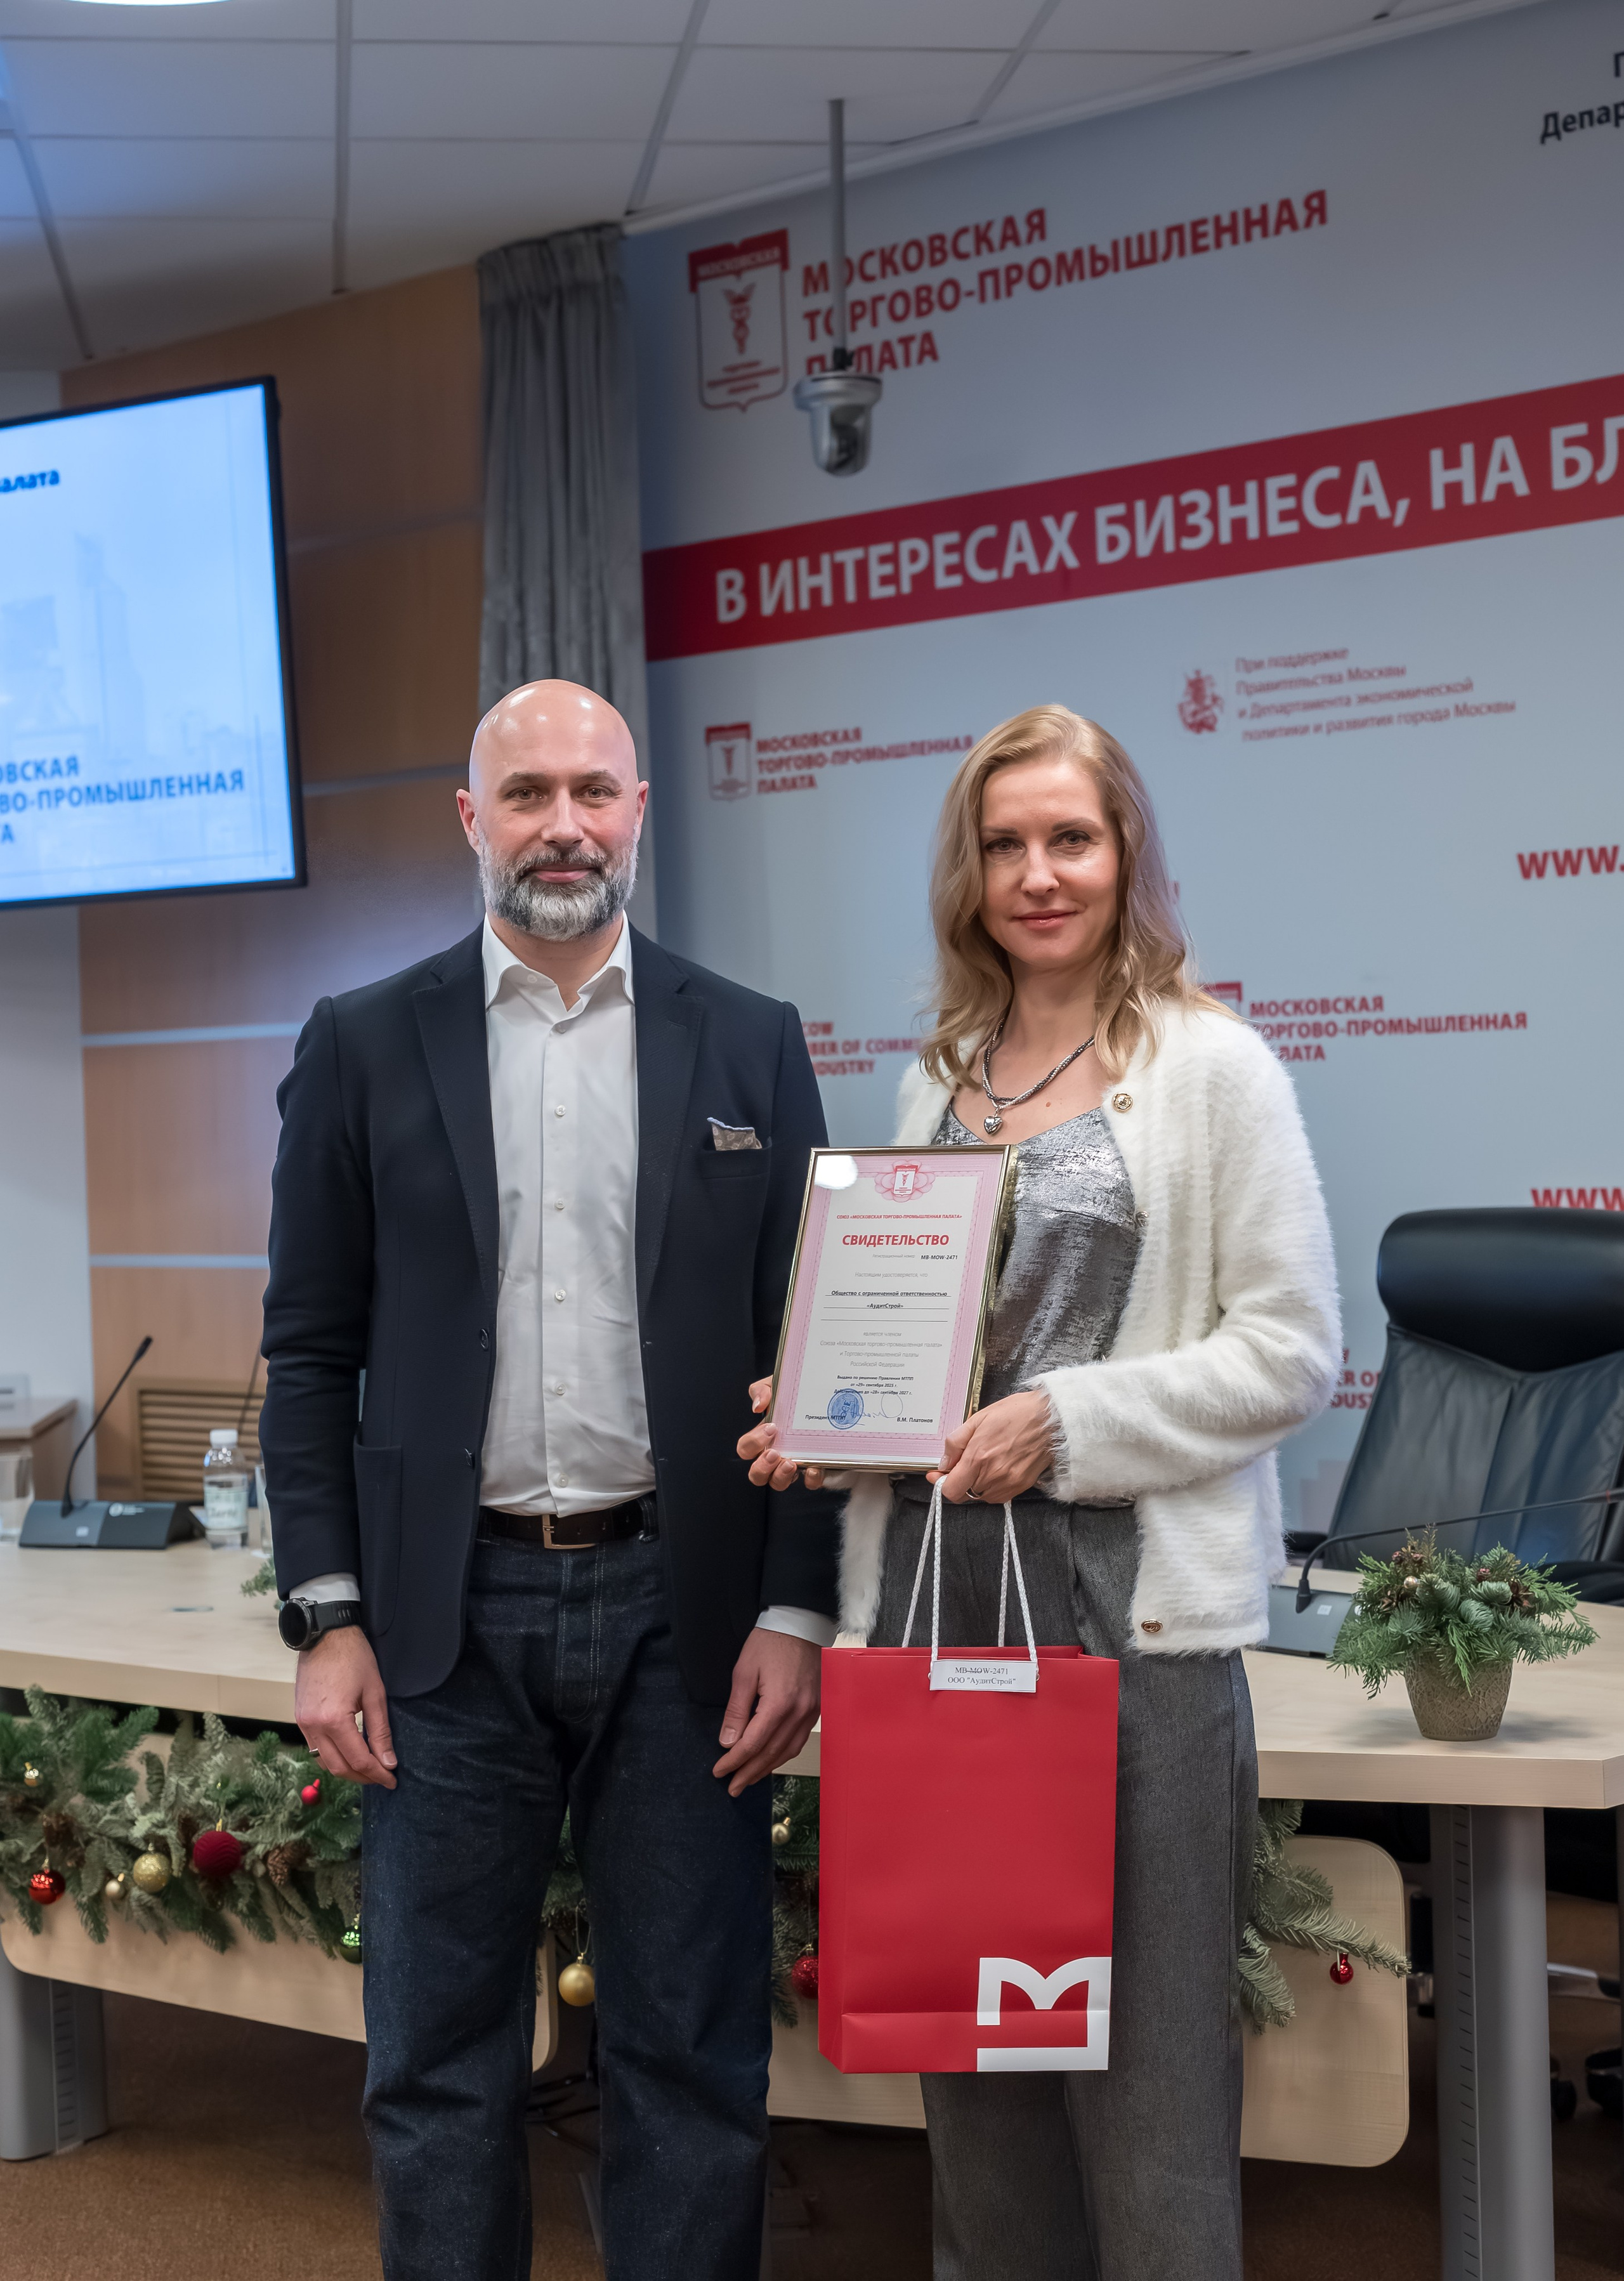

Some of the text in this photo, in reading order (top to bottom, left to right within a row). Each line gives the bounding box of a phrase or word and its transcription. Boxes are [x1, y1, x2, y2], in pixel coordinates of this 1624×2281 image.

[806, 331, 939, 376] ПЛАТА
[716, 568, 747, 624] В
[759, 511, 1080, 617] ИНТЕРЕСАХ
[1095, 459, 1411, 565] БИЗНЕСА,
[1429, 435, 1531, 511] НА
[757, 728, 862, 754] МОСКОВСКАЯ
[757, 735, 973, 773] ТОРГОВО-ПРОМЫШЛЕННАЯ
[0, 755, 79, 785] ВСКАЯ
[757, 774, 818, 794] ПАЛАТА
[1250, 995, 1384, 1018] МОСКОВСКАЯ
[1277, 1045, 1326, 1062] ЛАТА
[842, 1234, 950, 1248] СВИДЕТЕЛЬСТВО
